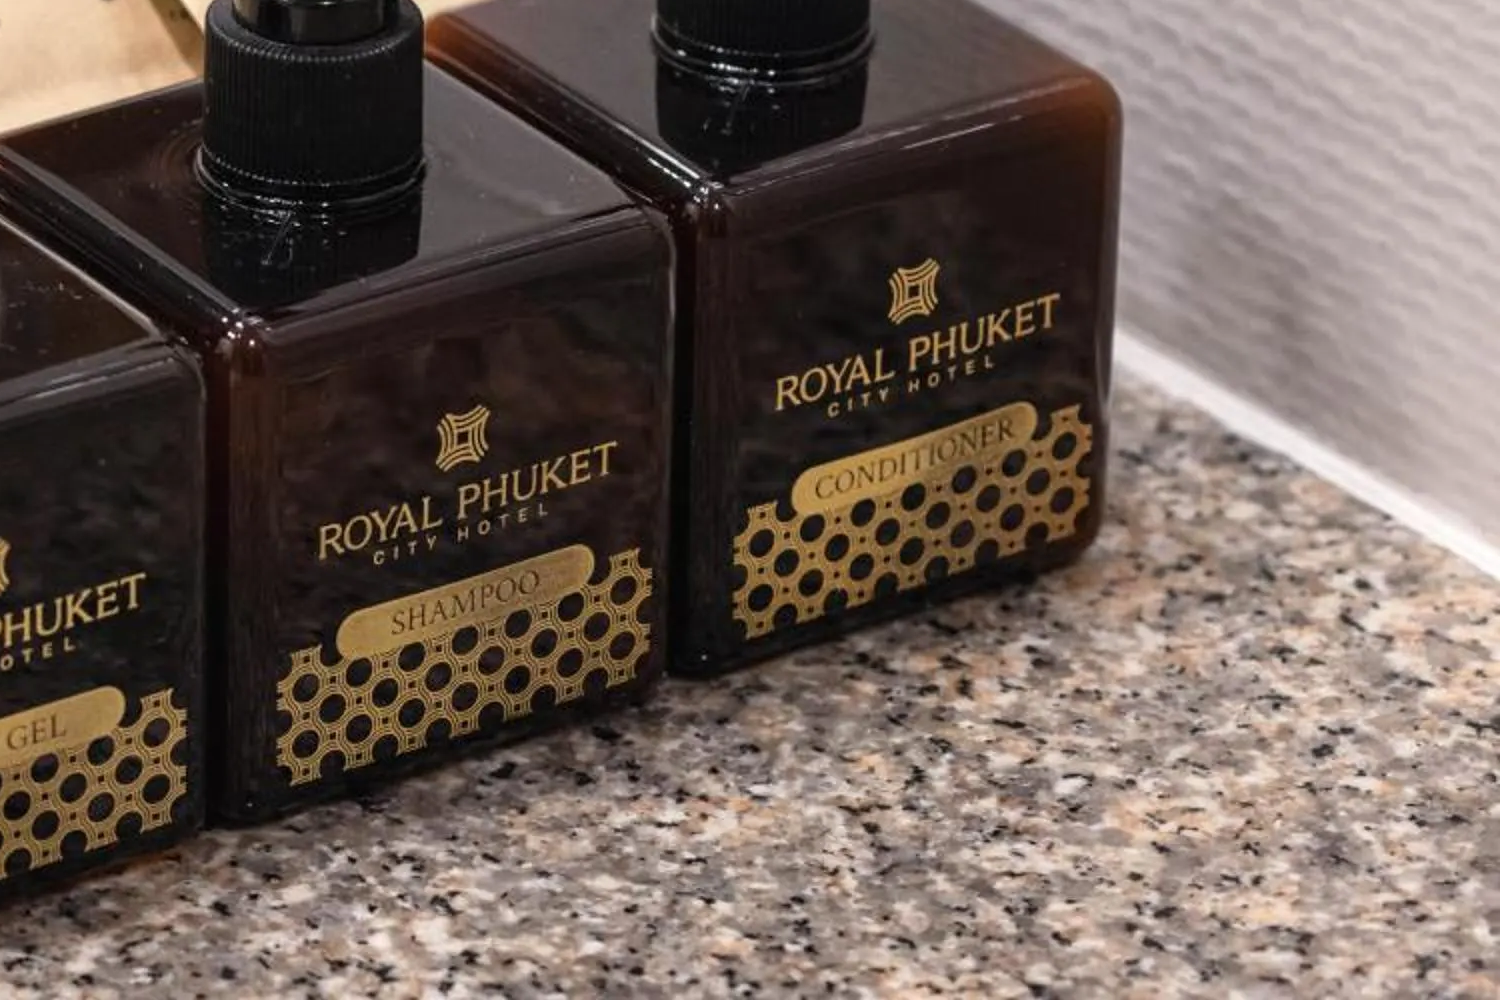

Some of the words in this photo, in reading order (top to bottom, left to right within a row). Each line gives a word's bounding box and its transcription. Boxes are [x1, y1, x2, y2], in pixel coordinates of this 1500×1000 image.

[774, 348, 896, 412] ROYAL
[908, 293, 1060, 373] PHUKET
[827, 387, 890, 418] CITY
[908, 354, 996, 394] HOTEL
[814, 417, 1016, 501] CONDITIONER
[318, 496, 443, 561] ROYAL
[456, 440, 618, 521] PHUKET
[372, 534, 439, 566] CITY
[456, 502, 550, 543] HOTEL
[390, 568, 542, 637] SHAMPOO
[6, 712, 68, 751] GEL
